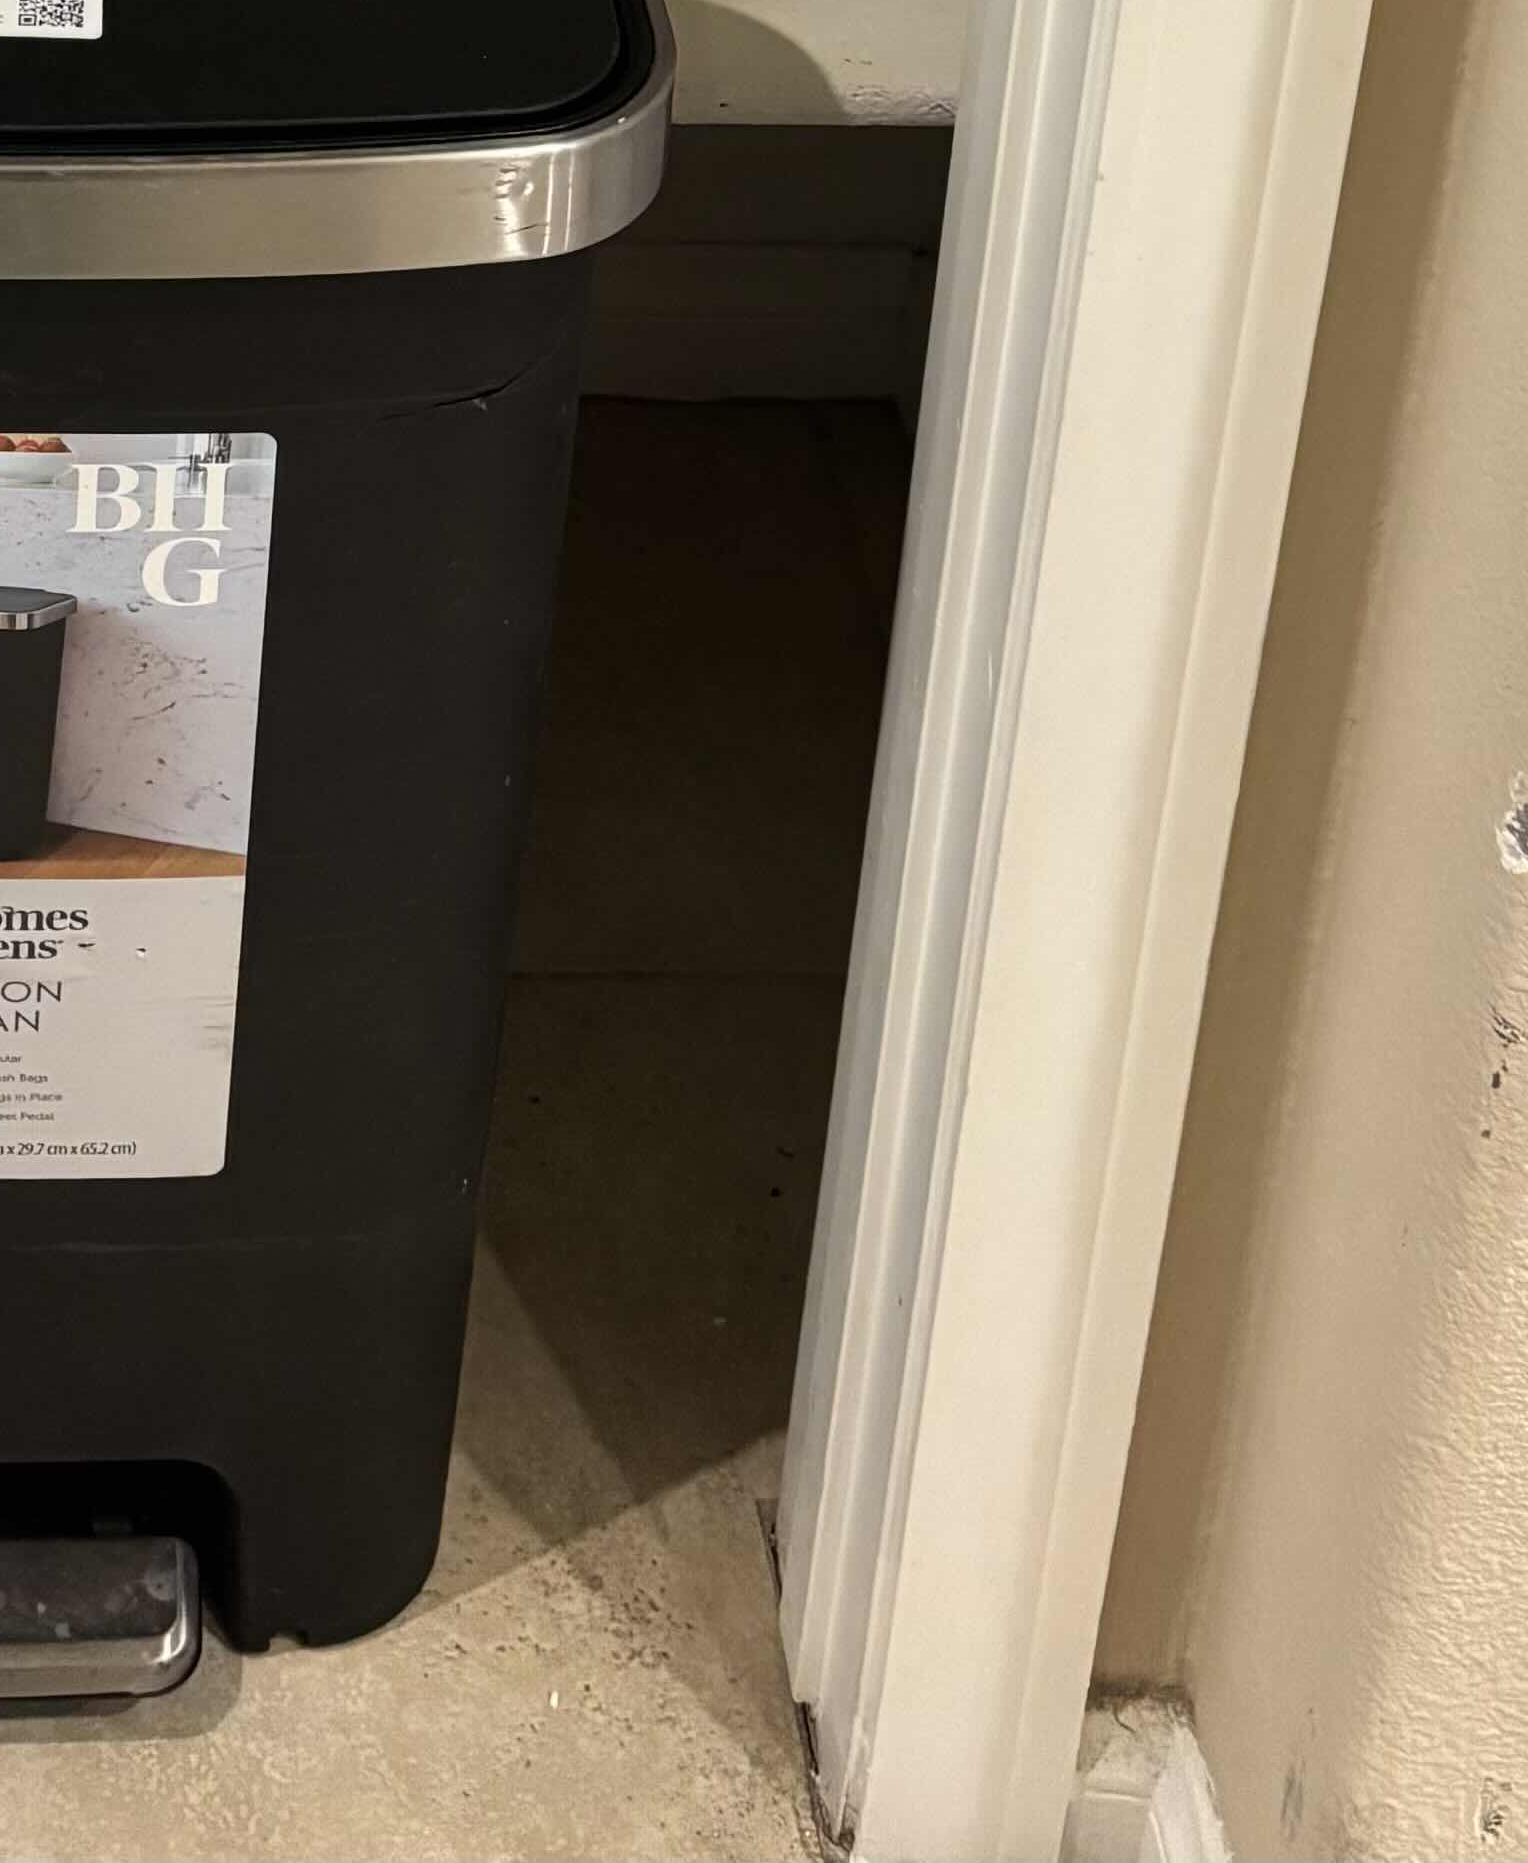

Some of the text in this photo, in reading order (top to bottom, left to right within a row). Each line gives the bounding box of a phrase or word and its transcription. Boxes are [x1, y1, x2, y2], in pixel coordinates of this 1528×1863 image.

[66, 462, 234, 533] BH
[141, 536, 228, 608] G
[14, 1093, 27, 1103] in
[29, 1092, 64, 1103] Place
[19, 1111, 55, 1122] Pedal
[6, 1145, 16, 1155] x
[17, 1141, 45, 1155] 29.7
[46, 1144, 69, 1155] cm
[70, 1144, 79, 1155] x
[79, 1142, 110, 1155] 65.2
[110, 1141, 138, 1156] cm)
